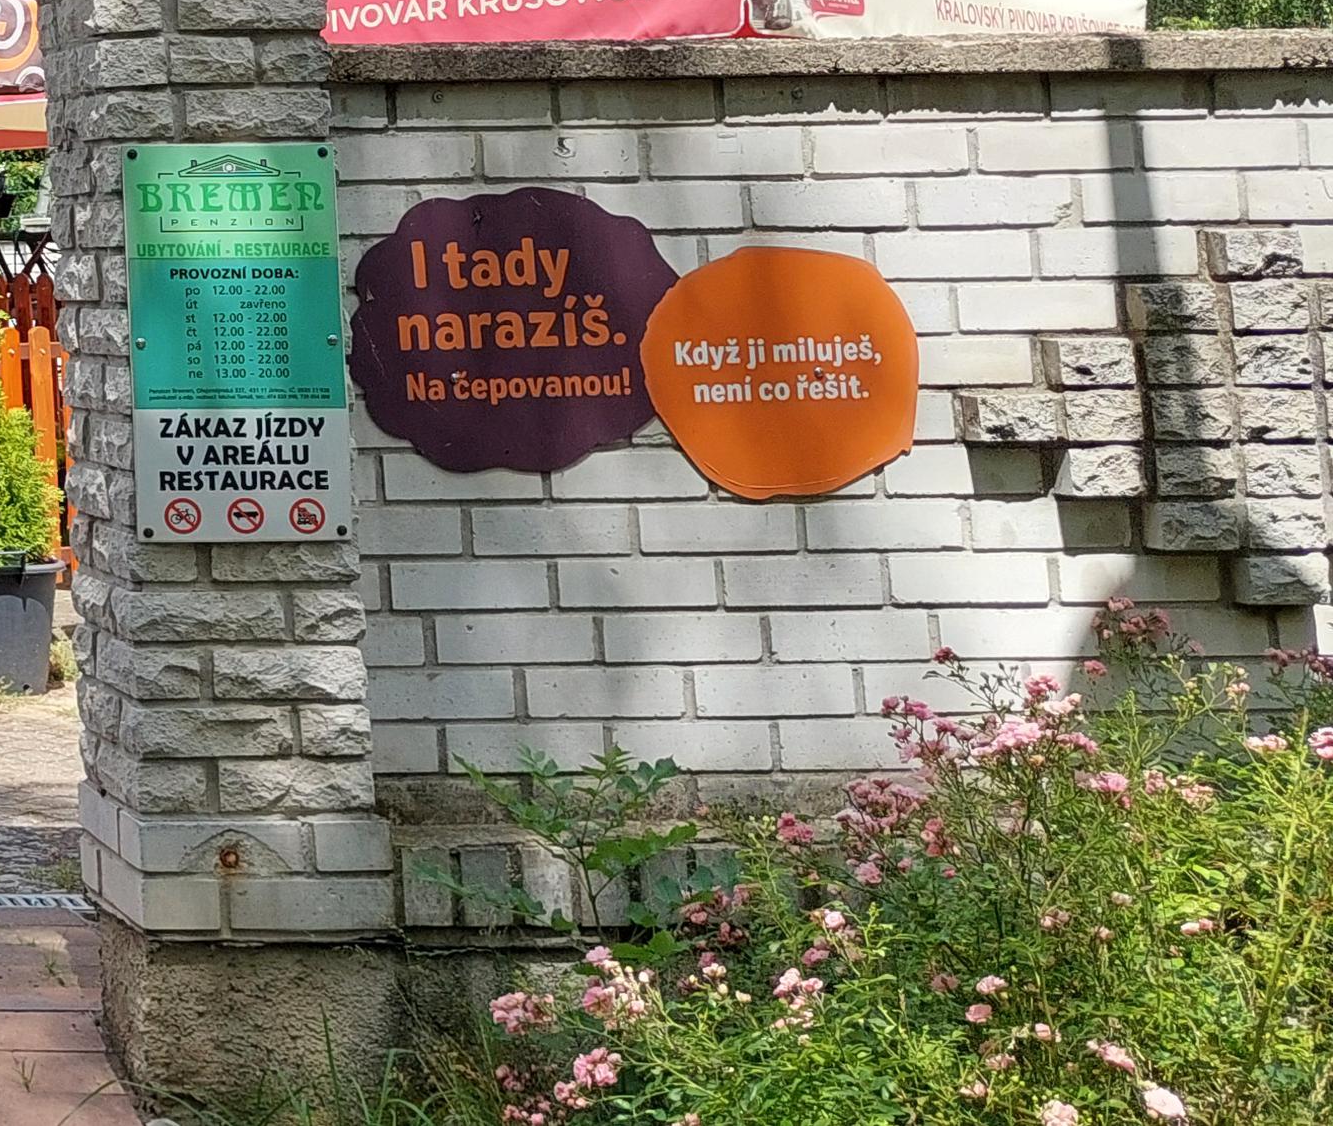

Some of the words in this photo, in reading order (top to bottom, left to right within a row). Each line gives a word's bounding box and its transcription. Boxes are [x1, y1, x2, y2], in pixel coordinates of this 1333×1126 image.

[1008, 8, 1057, 33] PIVOVAR
[137, 182, 324, 213] BREMEN
[171, 218, 295, 226] PENZION
[137, 239, 221, 258] UBYTOVÁNÍ
[234, 242, 330, 257] RESTAURACE
[170, 266, 247, 280] PROVOZNÍ
[251, 268, 300, 280] DOBA:
[411, 241, 429, 289] I
[442, 237, 570, 298] tady
[185, 287, 201, 298] po
[213, 285, 243, 295] 12.00
[255, 285, 286, 295] 22.00
[185, 298, 198, 310] út
[239, 298, 287, 310] zavřeno
[185, 314, 196, 323] st
[213, 313, 244, 323] 12.00
[256, 313, 288, 323] 22.00
[398, 294, 627, 351] narazíš.
[186, 326, 198, 337] čt
[213, 326, 244, 337] 12.00
[257, 326, 288, 337] 22.00
[187, 339, 201, 352] pá
[214, 340, 245, 351] 12.00
[257, 340, 289, 351] 22.00
[674, 337, 740, 371] Když
[746, 339, 765, 370] ji
[772, 336, 882, 368] miluješ,
[187, 356, 201, 365] so
[214, 354, 245, 365] 13.00
[258, 354, 290, 365] 22.00
[188, 370, 203, 379] ne
[215, 368, 246, 379] 13.00
[259, 368, 290, 379] 20.00
[406, 371, 445, 402] Na
[452, 367, 631, 405] čepovanou!
[694, 380, 751, 404] není
[759, 383, 790, 402] co
[796, 372, 870, 402] řešit.
[160, 412, 245, 438] ZÁKAZ
[256, 412, 325, 438] JÍZDY
[176, 447, 194, 465] V
[202, 440, 309, 465] AREÁLU
[160, 471, 330, 491] RESTAURACE
